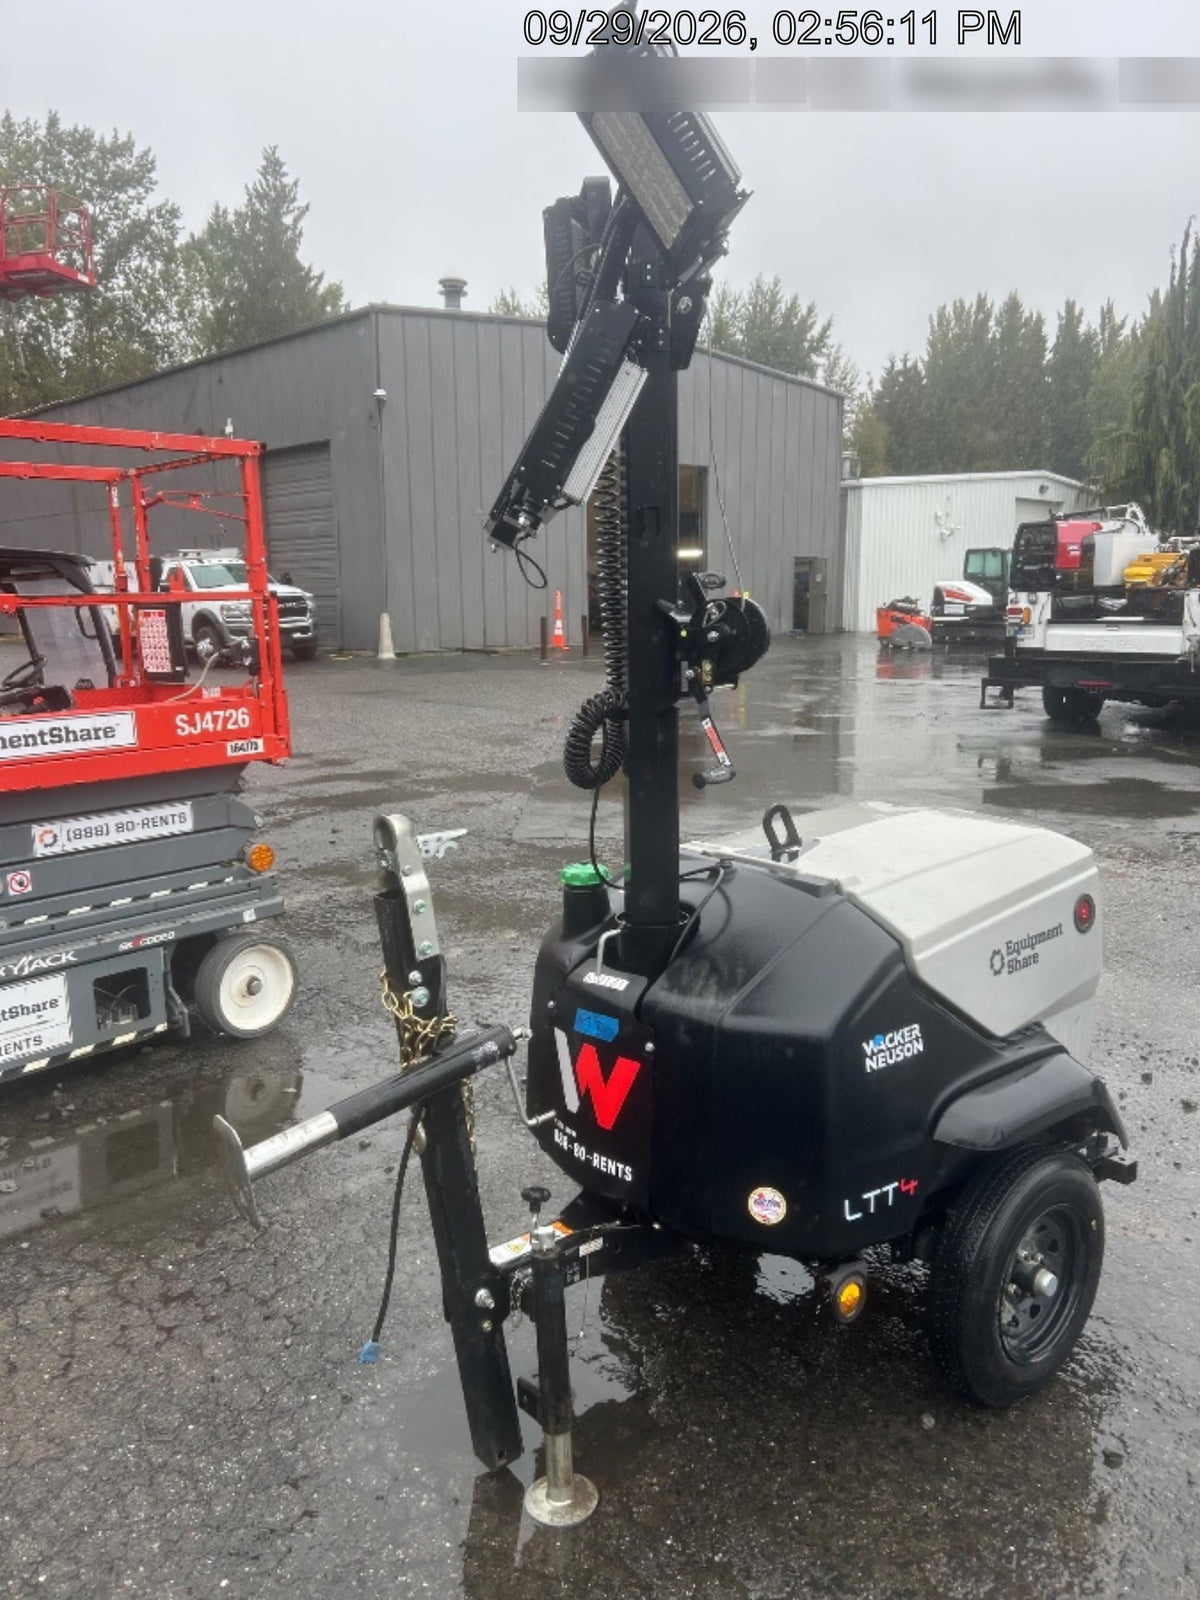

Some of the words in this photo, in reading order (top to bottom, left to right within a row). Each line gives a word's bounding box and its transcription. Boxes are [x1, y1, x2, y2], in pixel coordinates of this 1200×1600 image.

[175, 707, 250, 736] SJ4726
[115, 811, 188, 833] 80-RENTS
[1005, 922, 1064, 957] Equipment
[1007, 952, 1039, 975] Share
[865, 1038, 924, 1073] NEUSON
